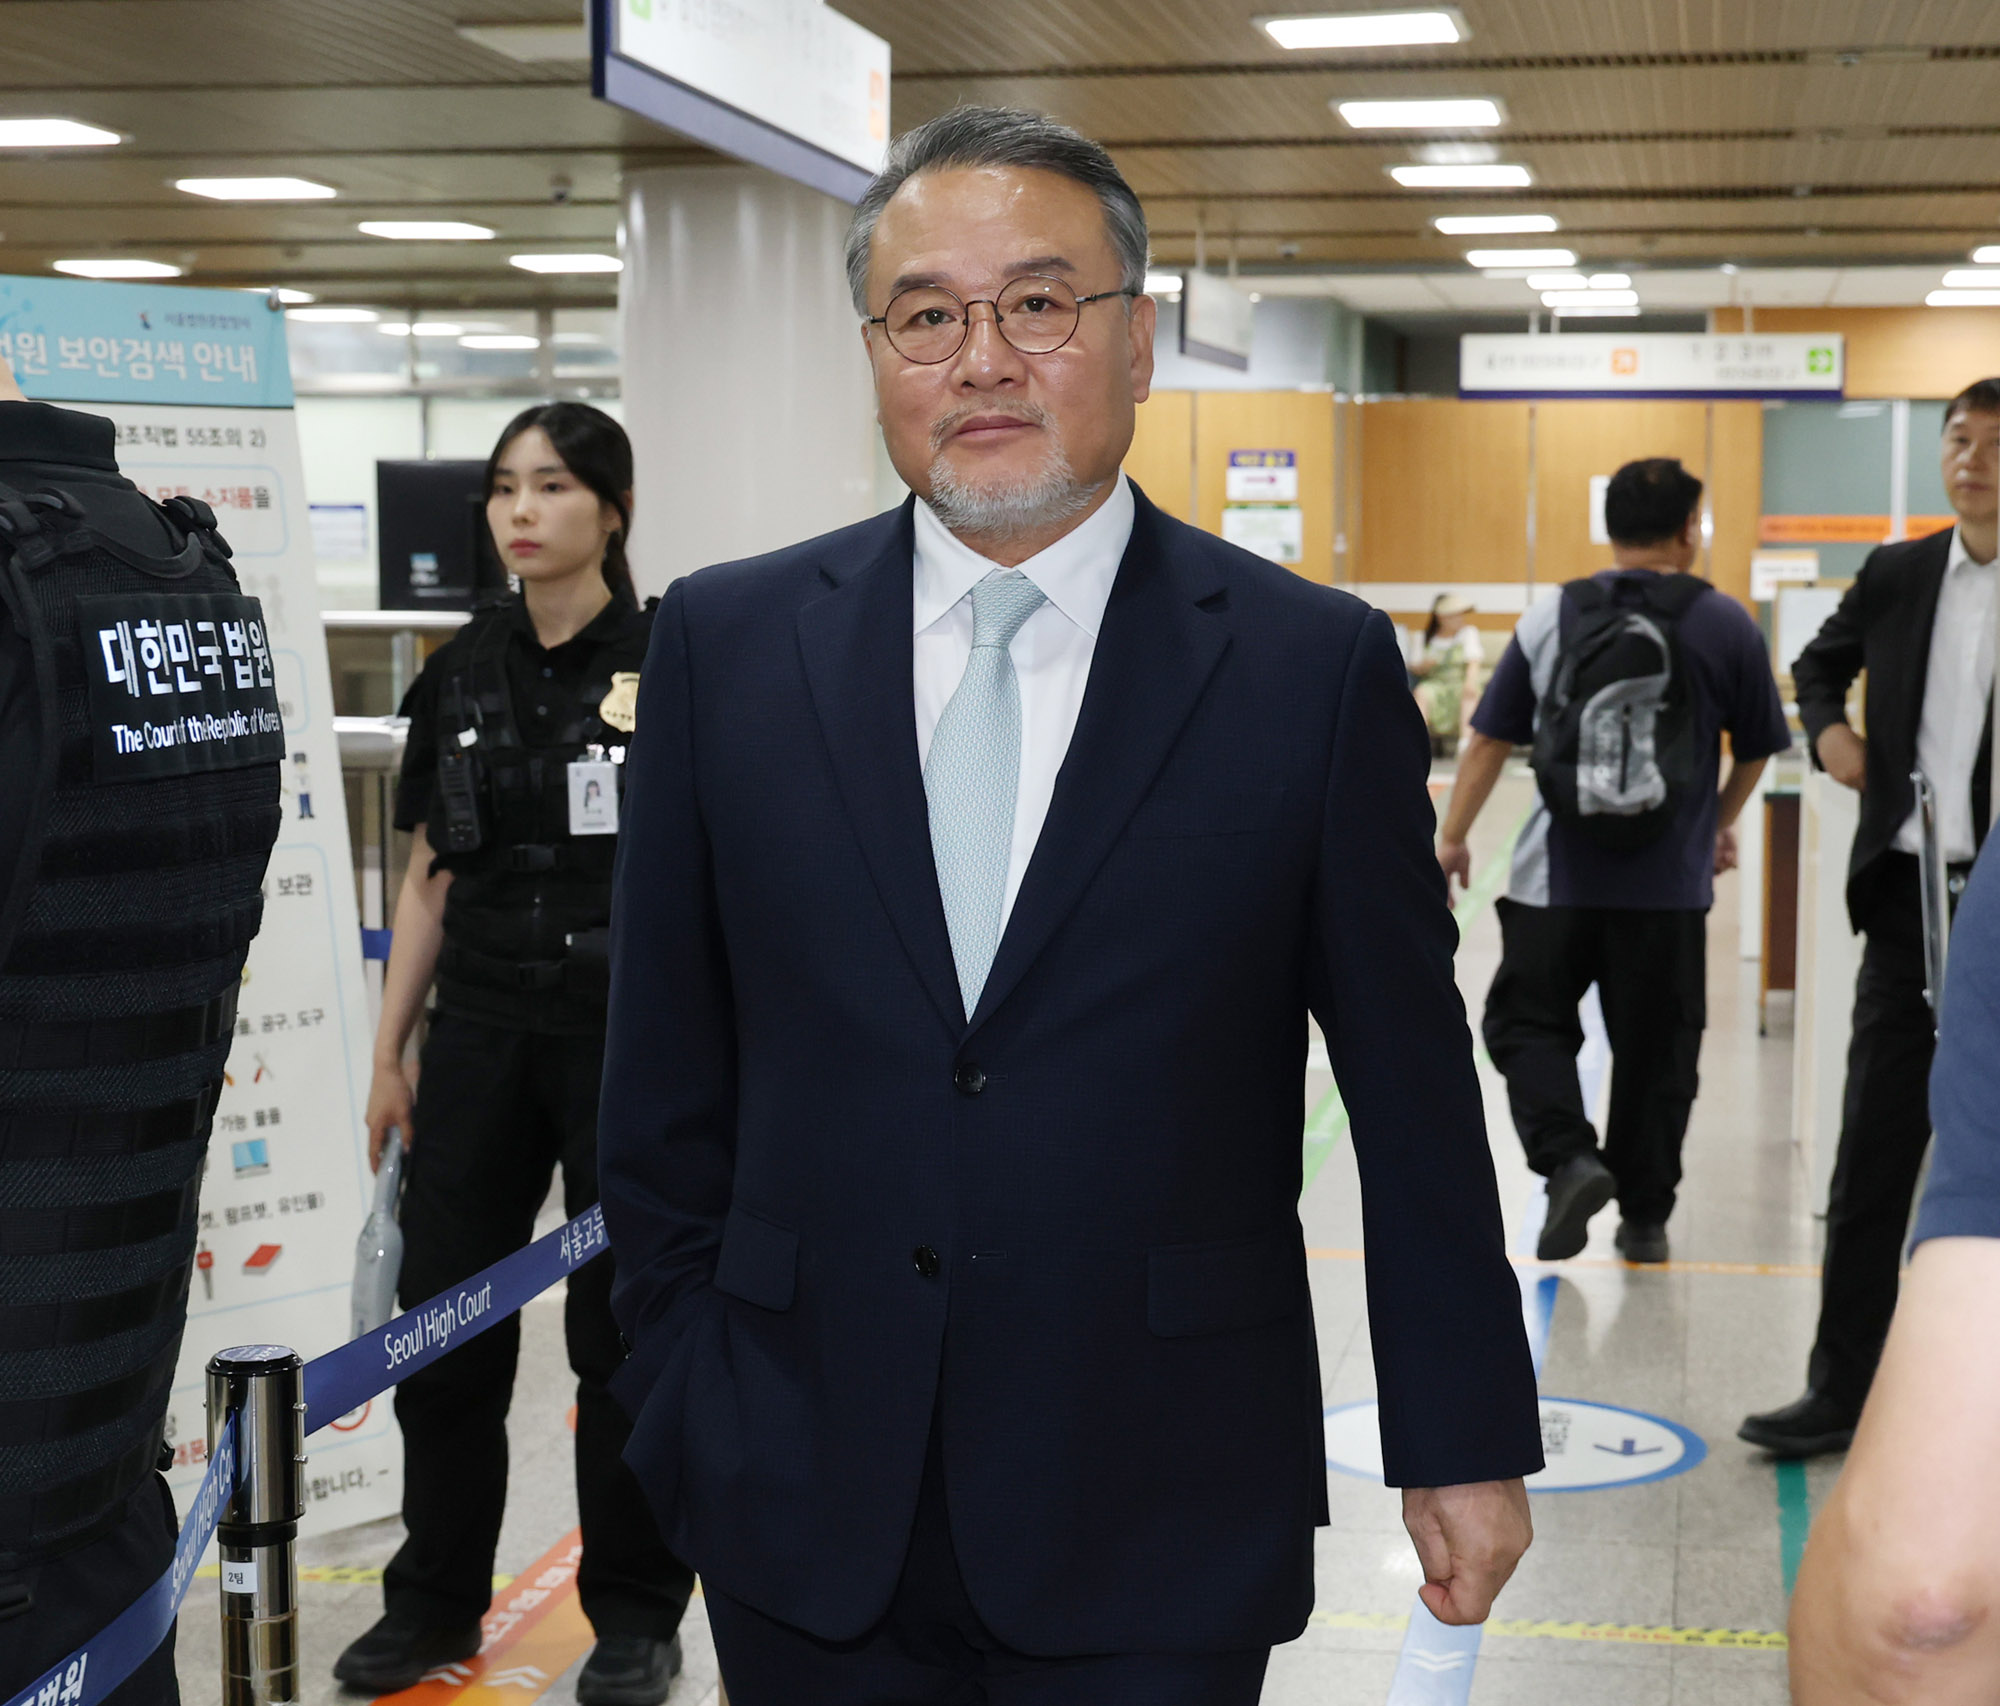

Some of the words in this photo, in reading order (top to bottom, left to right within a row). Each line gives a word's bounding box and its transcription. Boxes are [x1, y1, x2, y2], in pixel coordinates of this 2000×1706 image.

[57, 335, 189, 381] 보안검색
[193, 341, 259, 384] 안내
[112, 723, 144, 754] The
[257, 707, 281, 734] Korea
[277, 873, 314, 896] 보관
[297, 1008, 325, 1027] 도구
[384, 1315, 424, 1370] Seoul
[424, 1298, 456, 1348] High
[457, 1281, 492, 1327] Court
[198, 1468, 218, 1545] High
[228, 1571, 244, 1586] 2팀
